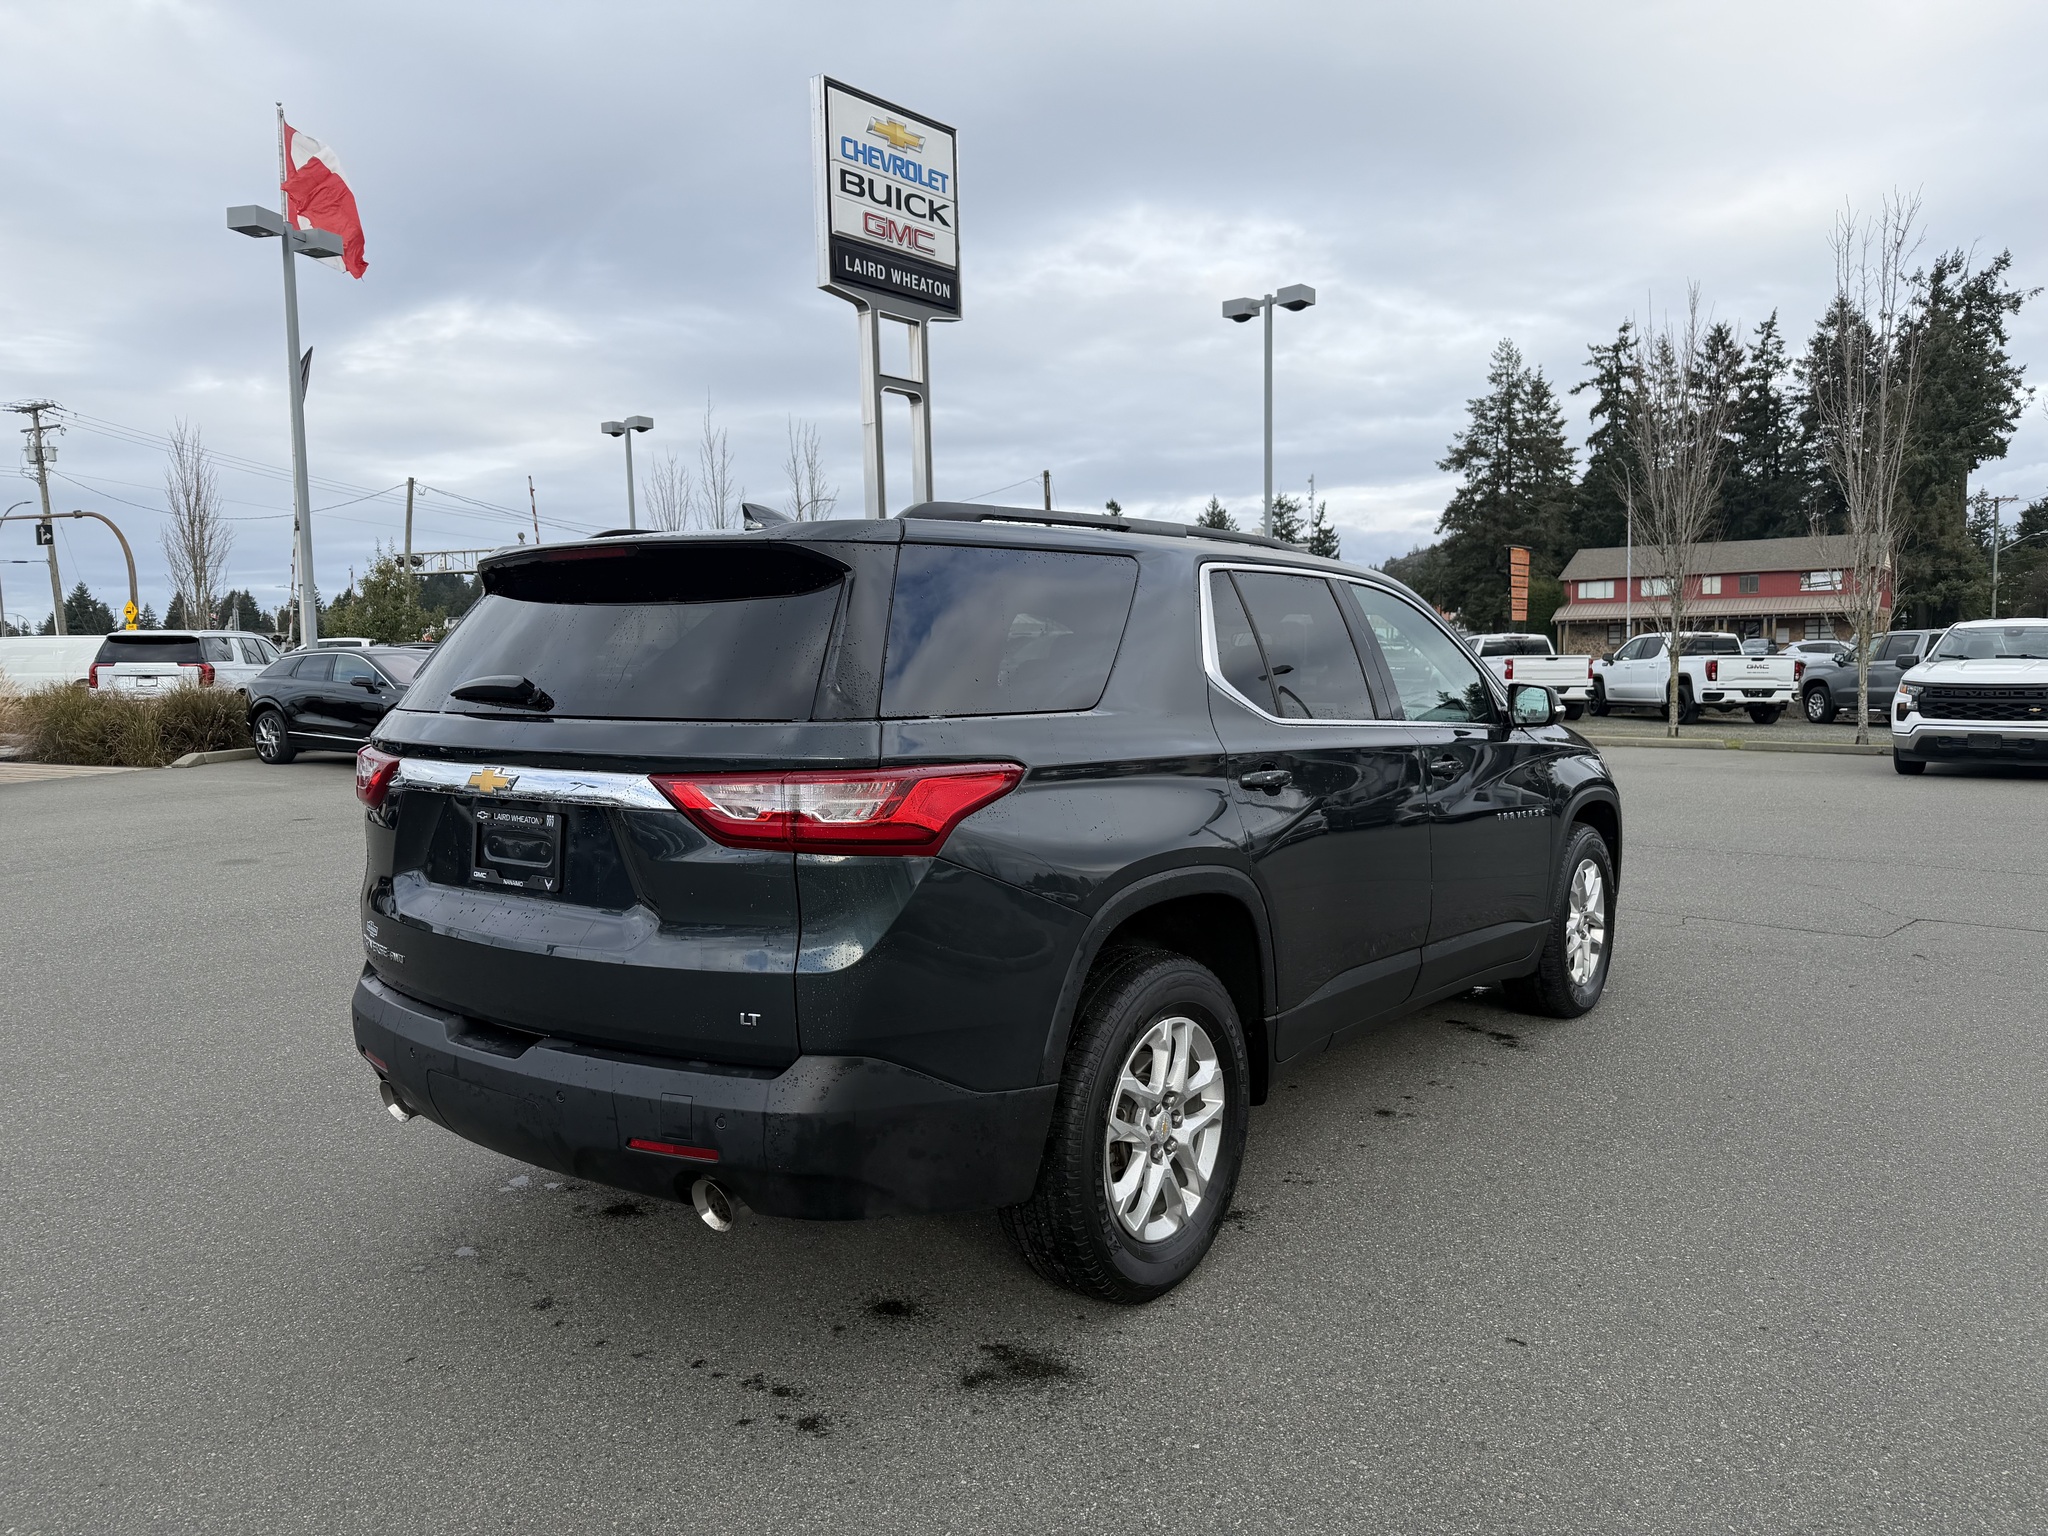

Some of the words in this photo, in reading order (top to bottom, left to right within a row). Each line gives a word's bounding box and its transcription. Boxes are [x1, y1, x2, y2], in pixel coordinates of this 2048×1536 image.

[841, 136, 949, 193] CHEVROLET
[839, 168, 951, 228] BUICK
[862, 210, 936, 256] GMC
[845, 255, 886, 281] LAIRD
[890, 268, 951, 299] WHEATON
[493, 812, 511, 821] LAIRD
[511, 814, 540, 825] WHEATON
[1497, 809, 1546, 821] TRAVERSE
[740, 1012, 761, 1026] LT
